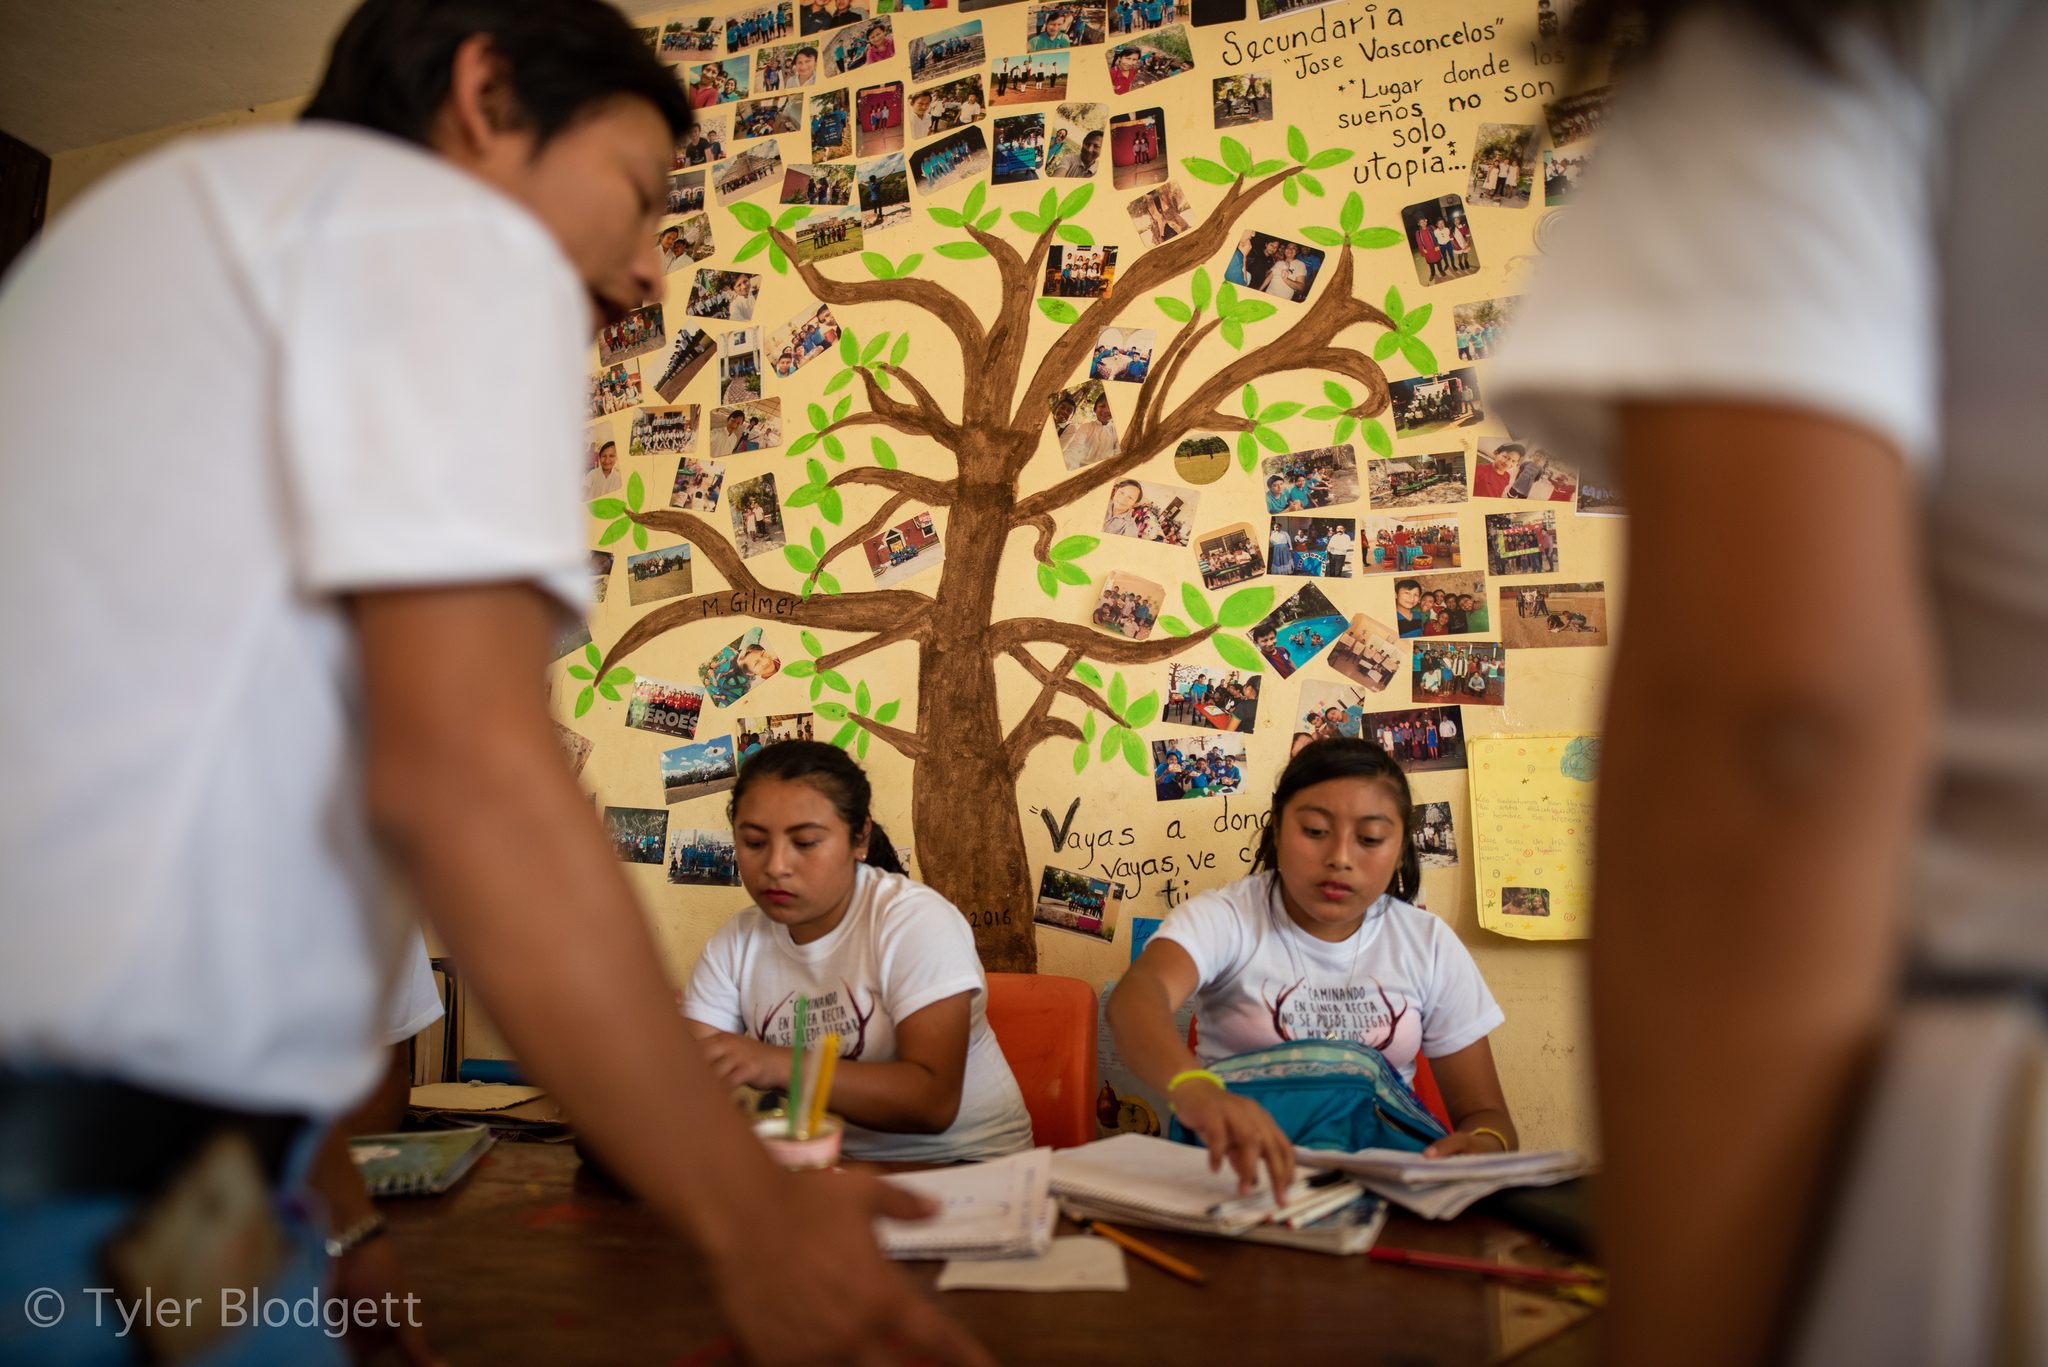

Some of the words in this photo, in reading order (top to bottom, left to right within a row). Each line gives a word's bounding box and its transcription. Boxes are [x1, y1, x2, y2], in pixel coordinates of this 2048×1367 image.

[1222, 4, 1404, 66] Secundaria
[1443, 52, 1511, 84] donde
[1530, 41, 1566, 66] los
[1338, 103, 1424, 129] sueños
[1448, 94, 1482, 112] no
[1504, 80, 1556, 102] son
[1393, 117, 1446, 147] solo
[702, 598, 724, 618] M.
[730, 589, 804, 615] Gilmer
[1166, 820, 1186, 839] a
[1101, 857, 1180, 899] vayas,
[1187, 850, 1217, 870] ve
[969, 909, 1012, 928] 2016
[778, 1016, 790, 1031] EN
[822, 1006, 847, 1023] RECTA
[1281, 1012, 1295, 1026] NO
[1300, 1014, 1311, 1028] SE
[1317, 1013, 1348, 1029] PUEDE
[1352, 1013, 1393, 1029] LLEGAR
[1294, 1000, 1307, 1012] EN
[1345, 1001, 1379, 1014] RECTA
[780, 1031, 791, 1046] SE
